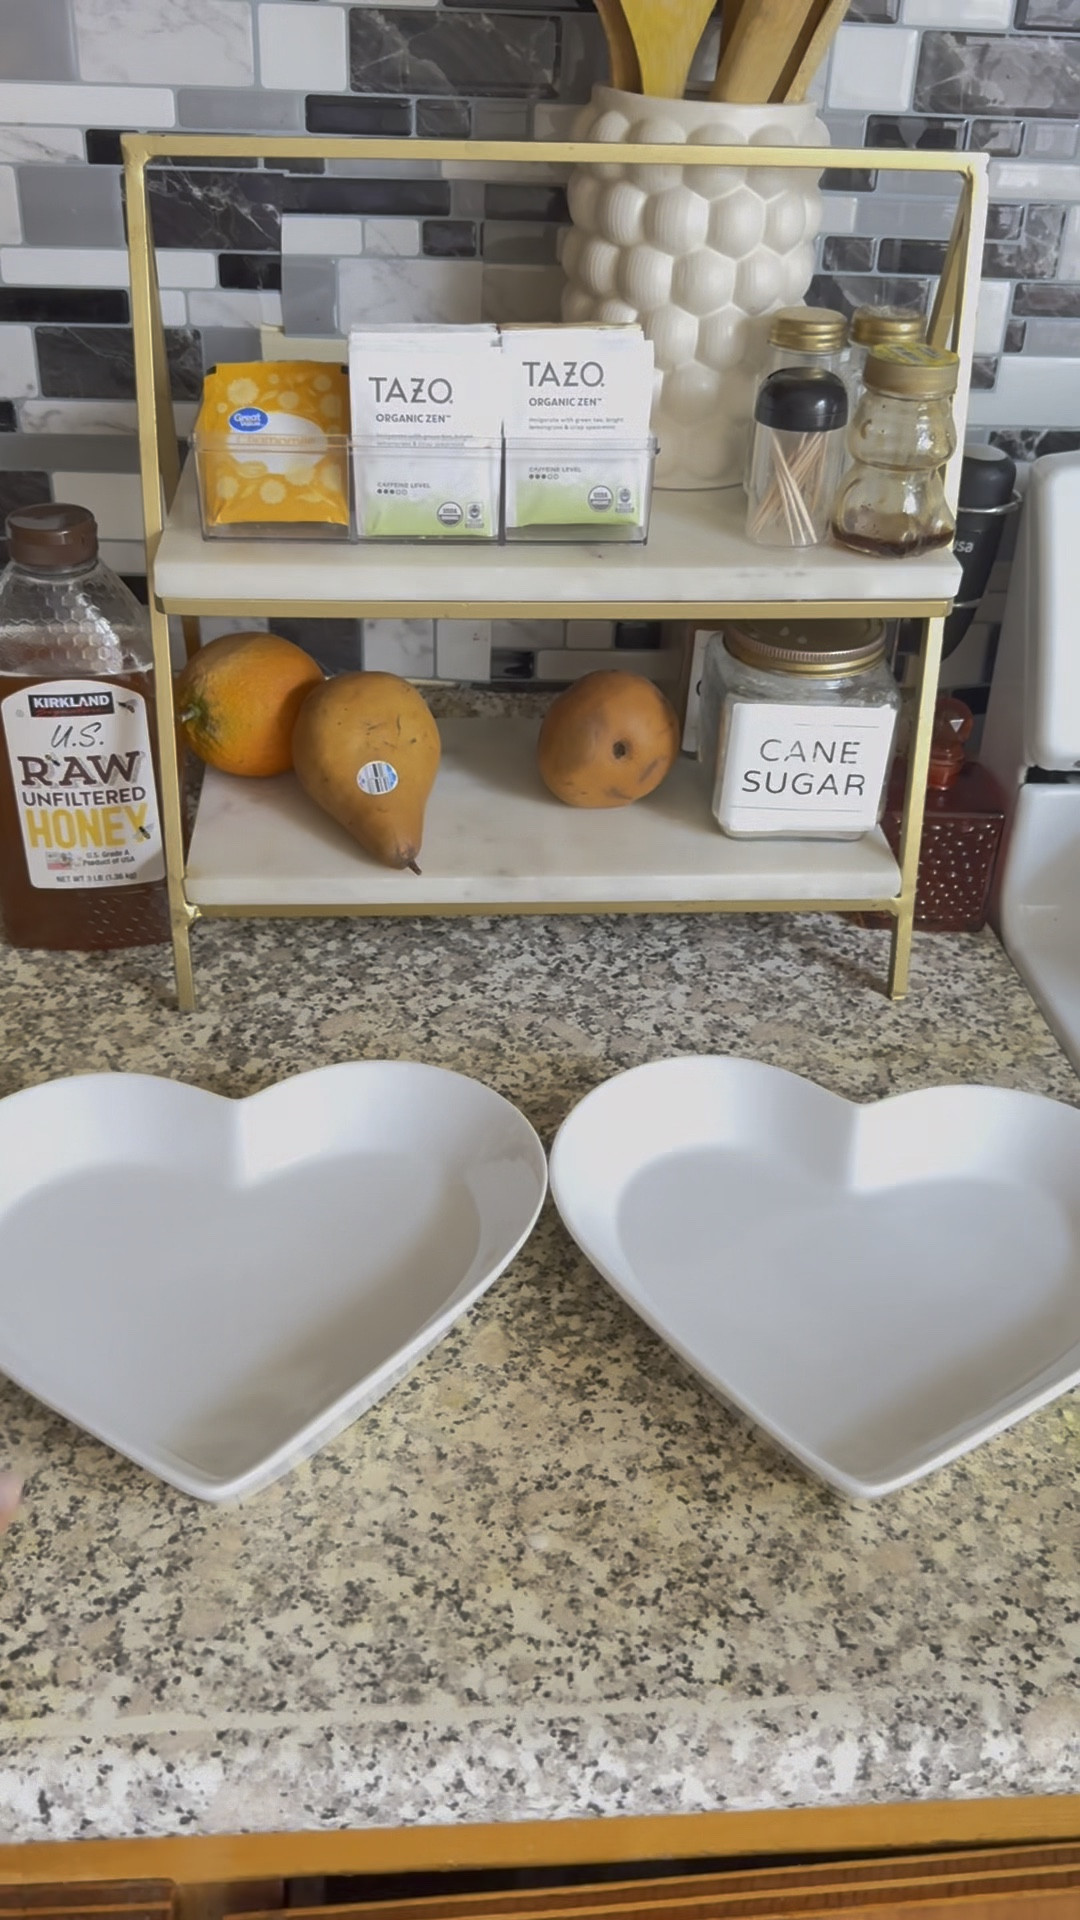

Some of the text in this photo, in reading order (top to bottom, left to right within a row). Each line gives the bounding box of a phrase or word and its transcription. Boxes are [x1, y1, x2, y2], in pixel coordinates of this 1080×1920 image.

[528, 397, 576, 407] ORGANIC
[233, 413, 261, 422] Great
[375, 413, 424, 423] ORGANIC
[33, 694, 110, 708] KIRKLAND
[51, 722, 105, 748] U.S.
[760, 738, 861, 765] CANE
[17, 750, 142, 787] RAW
[741, 769, 866, 797] SUGAR
[22, 787, 147, 807] UNFILTERED
[25, 802, 150, 849] HONEY
[83, 858, 111, 866] Product
